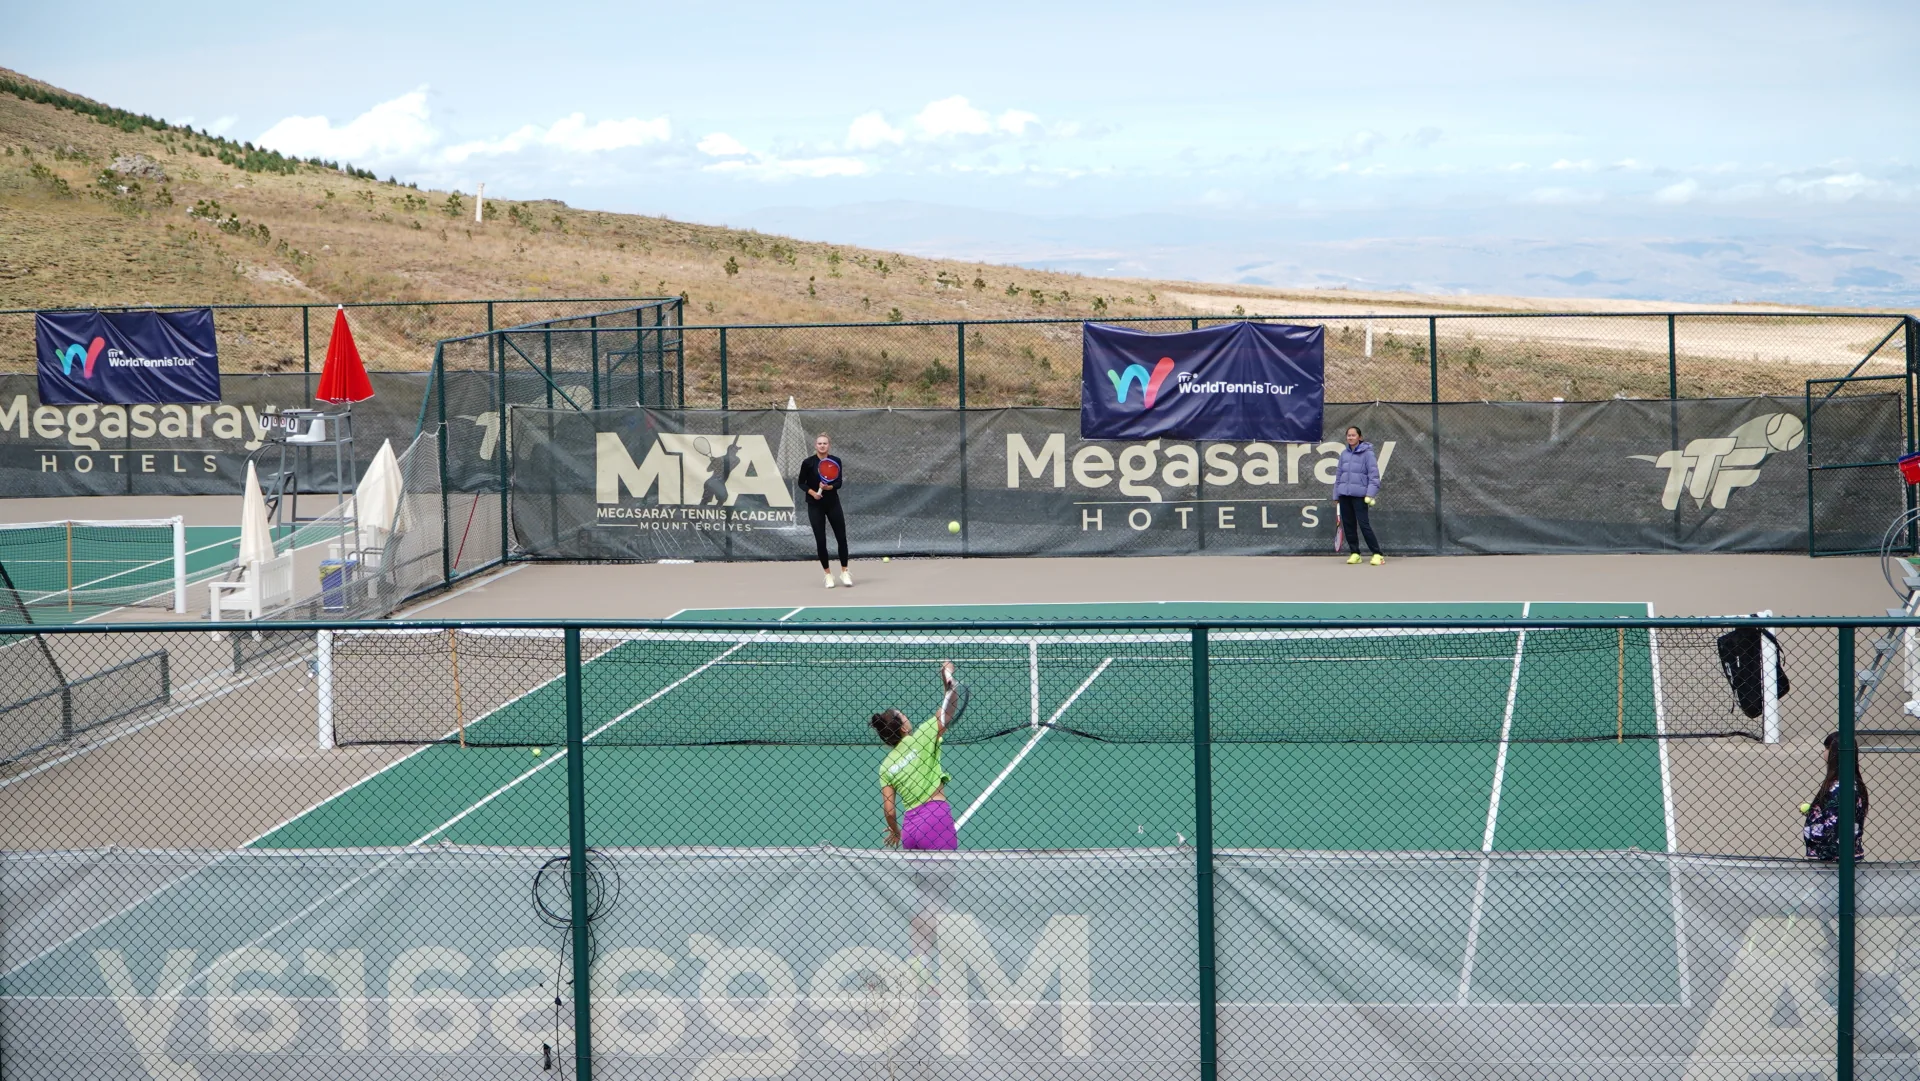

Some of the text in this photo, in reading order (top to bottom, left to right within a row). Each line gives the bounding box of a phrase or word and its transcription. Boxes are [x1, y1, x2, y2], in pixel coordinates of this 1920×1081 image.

[42, 455, 217, 473] HOTELS
[596, 507, 796, 522] MEGASARAY TENNIS ACADEMY
[1083, 506, 1319, 531] HOTELS
[640, 522, 688, 531] MOUNT
